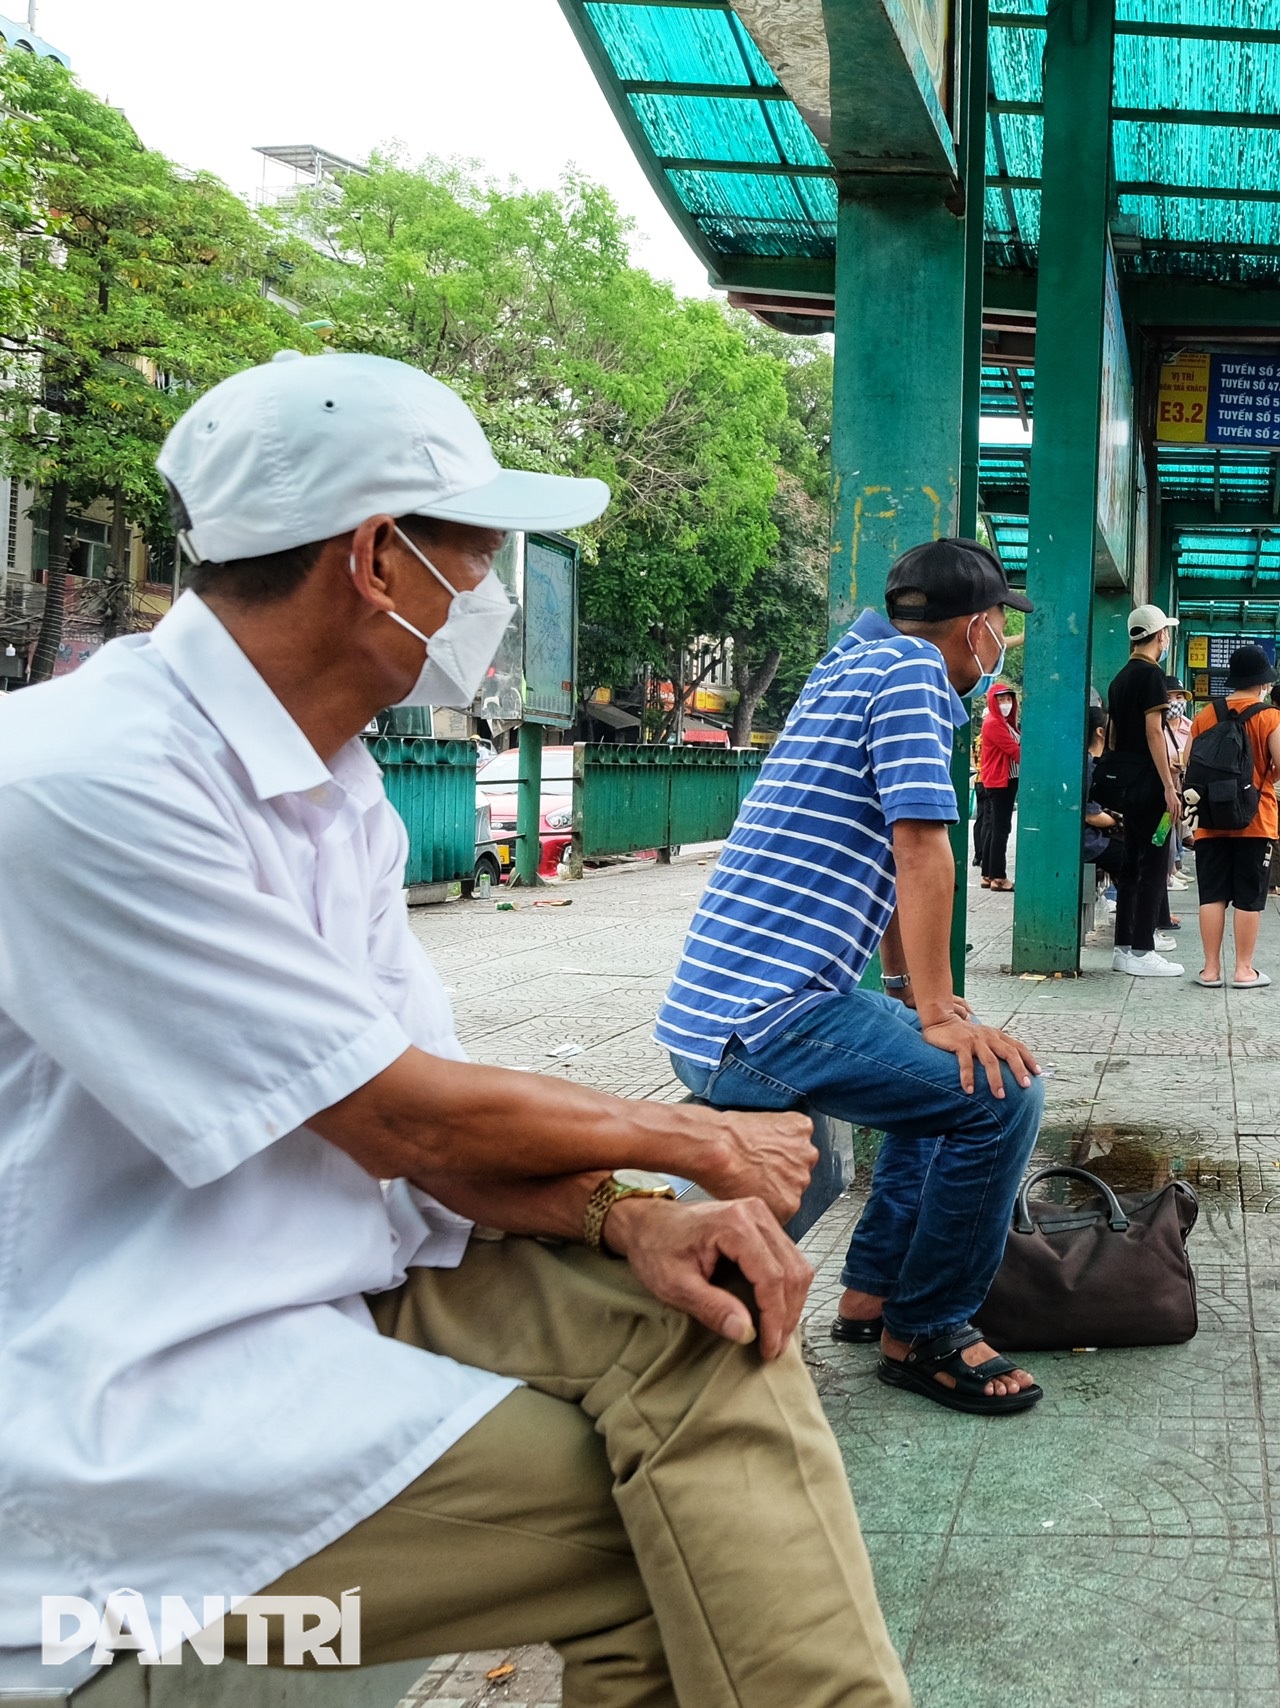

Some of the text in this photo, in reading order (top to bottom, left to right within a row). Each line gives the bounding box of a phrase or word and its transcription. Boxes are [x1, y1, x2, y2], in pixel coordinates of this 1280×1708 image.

[1221, 362, 1256, 375] TUYẾN
[1258, 364, 1274, 376] SỐ
[1221, 377, 1250, 389] TUYẾN
[1252, 378, 1266, 390] SỐ
[1219, 392, 1253, 405] TUYẾN
[1255, 394, 1271, 406] SỐ
[1160, 401, 1204, 423] E3.2
[1218, 408, 1253, 421] TUYẾN
[1256, 410, 1271, 422] SỐ
[1217, 425, 1252, 438] TUYẾN
[1255, 427, 1271, 438] SỐ
